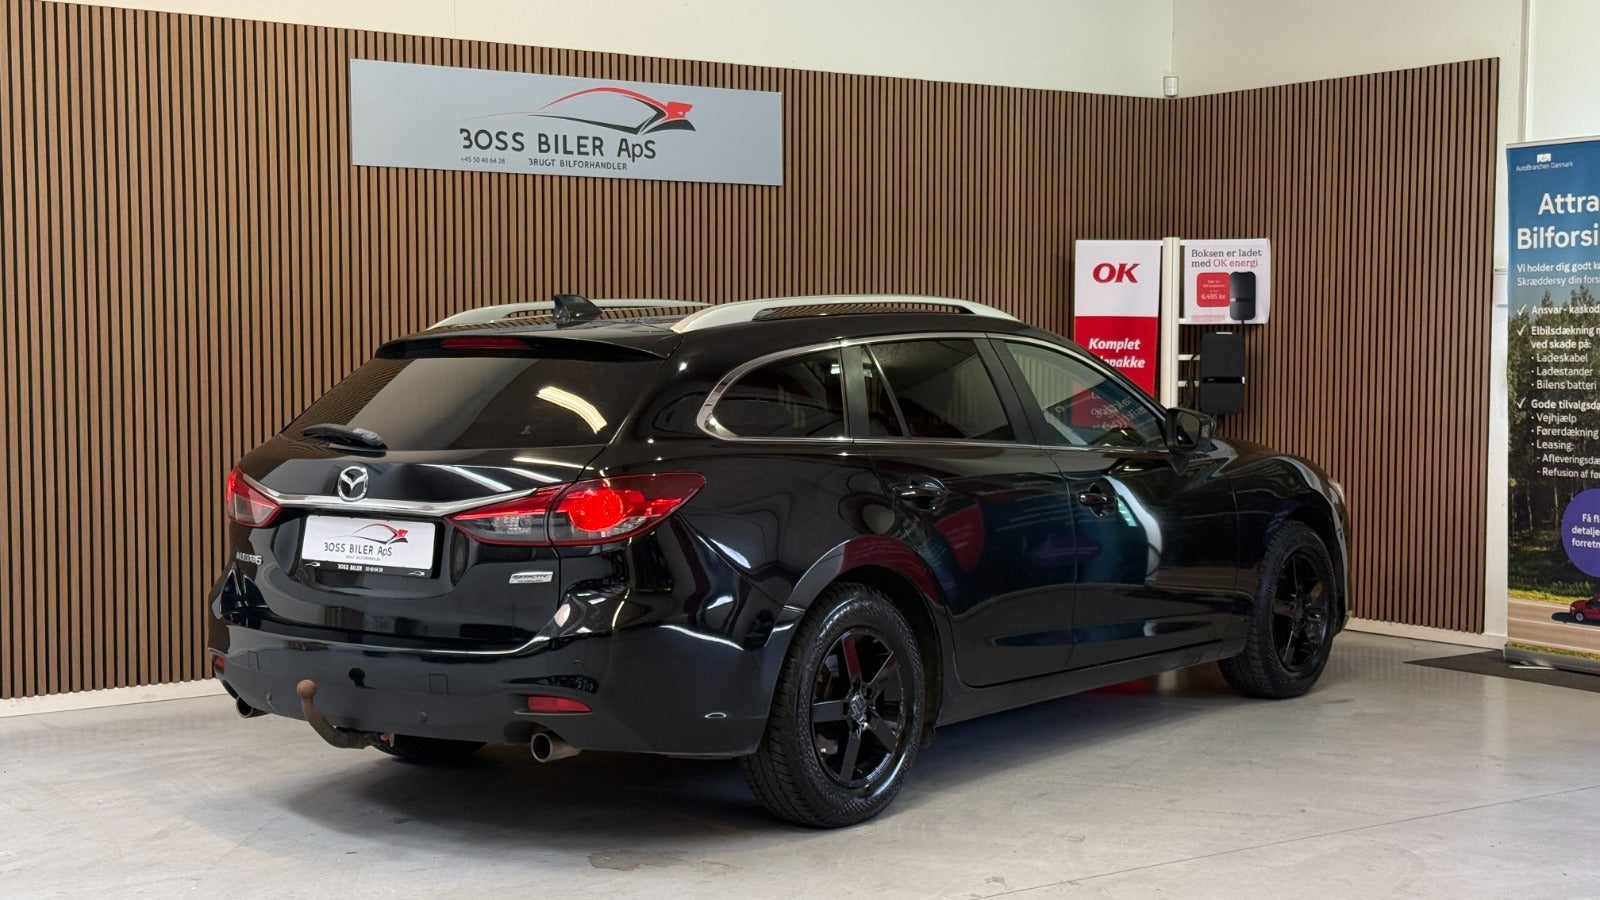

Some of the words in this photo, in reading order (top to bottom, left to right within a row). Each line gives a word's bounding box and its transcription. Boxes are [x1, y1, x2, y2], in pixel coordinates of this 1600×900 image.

[538, 133, 604, 156] BILER
[617, 138, 656, 162] ApS
[481, 156, 488, 165] 40
[560, 159, 627, 170] BILFORHANDLER
[1538, 193, 1600, 215] Attra
[1517, 223, 1599, 249] Bilforsi
[1191, 249, 1224, 257] Boksen
[1238, 249, 1262, 257] ladet
[1213, 259, 1228, 267] OK
[1229, 259, 1258, 268] energi
[1517, 264, 1526, 273] Vi
[1527, 264, 1554, 272] holder
[1556, 262, 1570, 272] dig
[1571, 262, 1592, 272] godt
[1093, 263, 1141, 283] OK
[1517, 277, 1566, 287] Skræddersy
[1568, 275, 1582, 284] din
[1569, 304, 1600, 314] kaskod
[1531, 326, 1595, 337] Elbilsdækning
[1089, 338, 1141, 353] Komplet
[1531, 340, 1548, 349] ved
[1550, 339, 1576, 349] skade
[1578, 339, 1592, 351] på:
[1101, 356, 1146, 368] pakke
[1537, 353, 1588, 363] Ladeskabel
[1537, 366, 1593, 377] Ladestander
[1537, 380, 1566, 390] Bilens
[1568, 380, 1597, 390] batteri
[1531, 400, 1556, 409] Gode
[1537, 413, 1577, 425] Vejhjælp
[1537, 426, 1599, 439] Førerdækning
[1537, 440, 1575, 452] Leasing:
[1543, 468, 1579, 478] Refusion
[1580, 470, 1589, 479] af
[1582, 513, 1592, 523] Få
[349, 544, 374, 555] BILER
[377, 546, 392, 557] ApS
